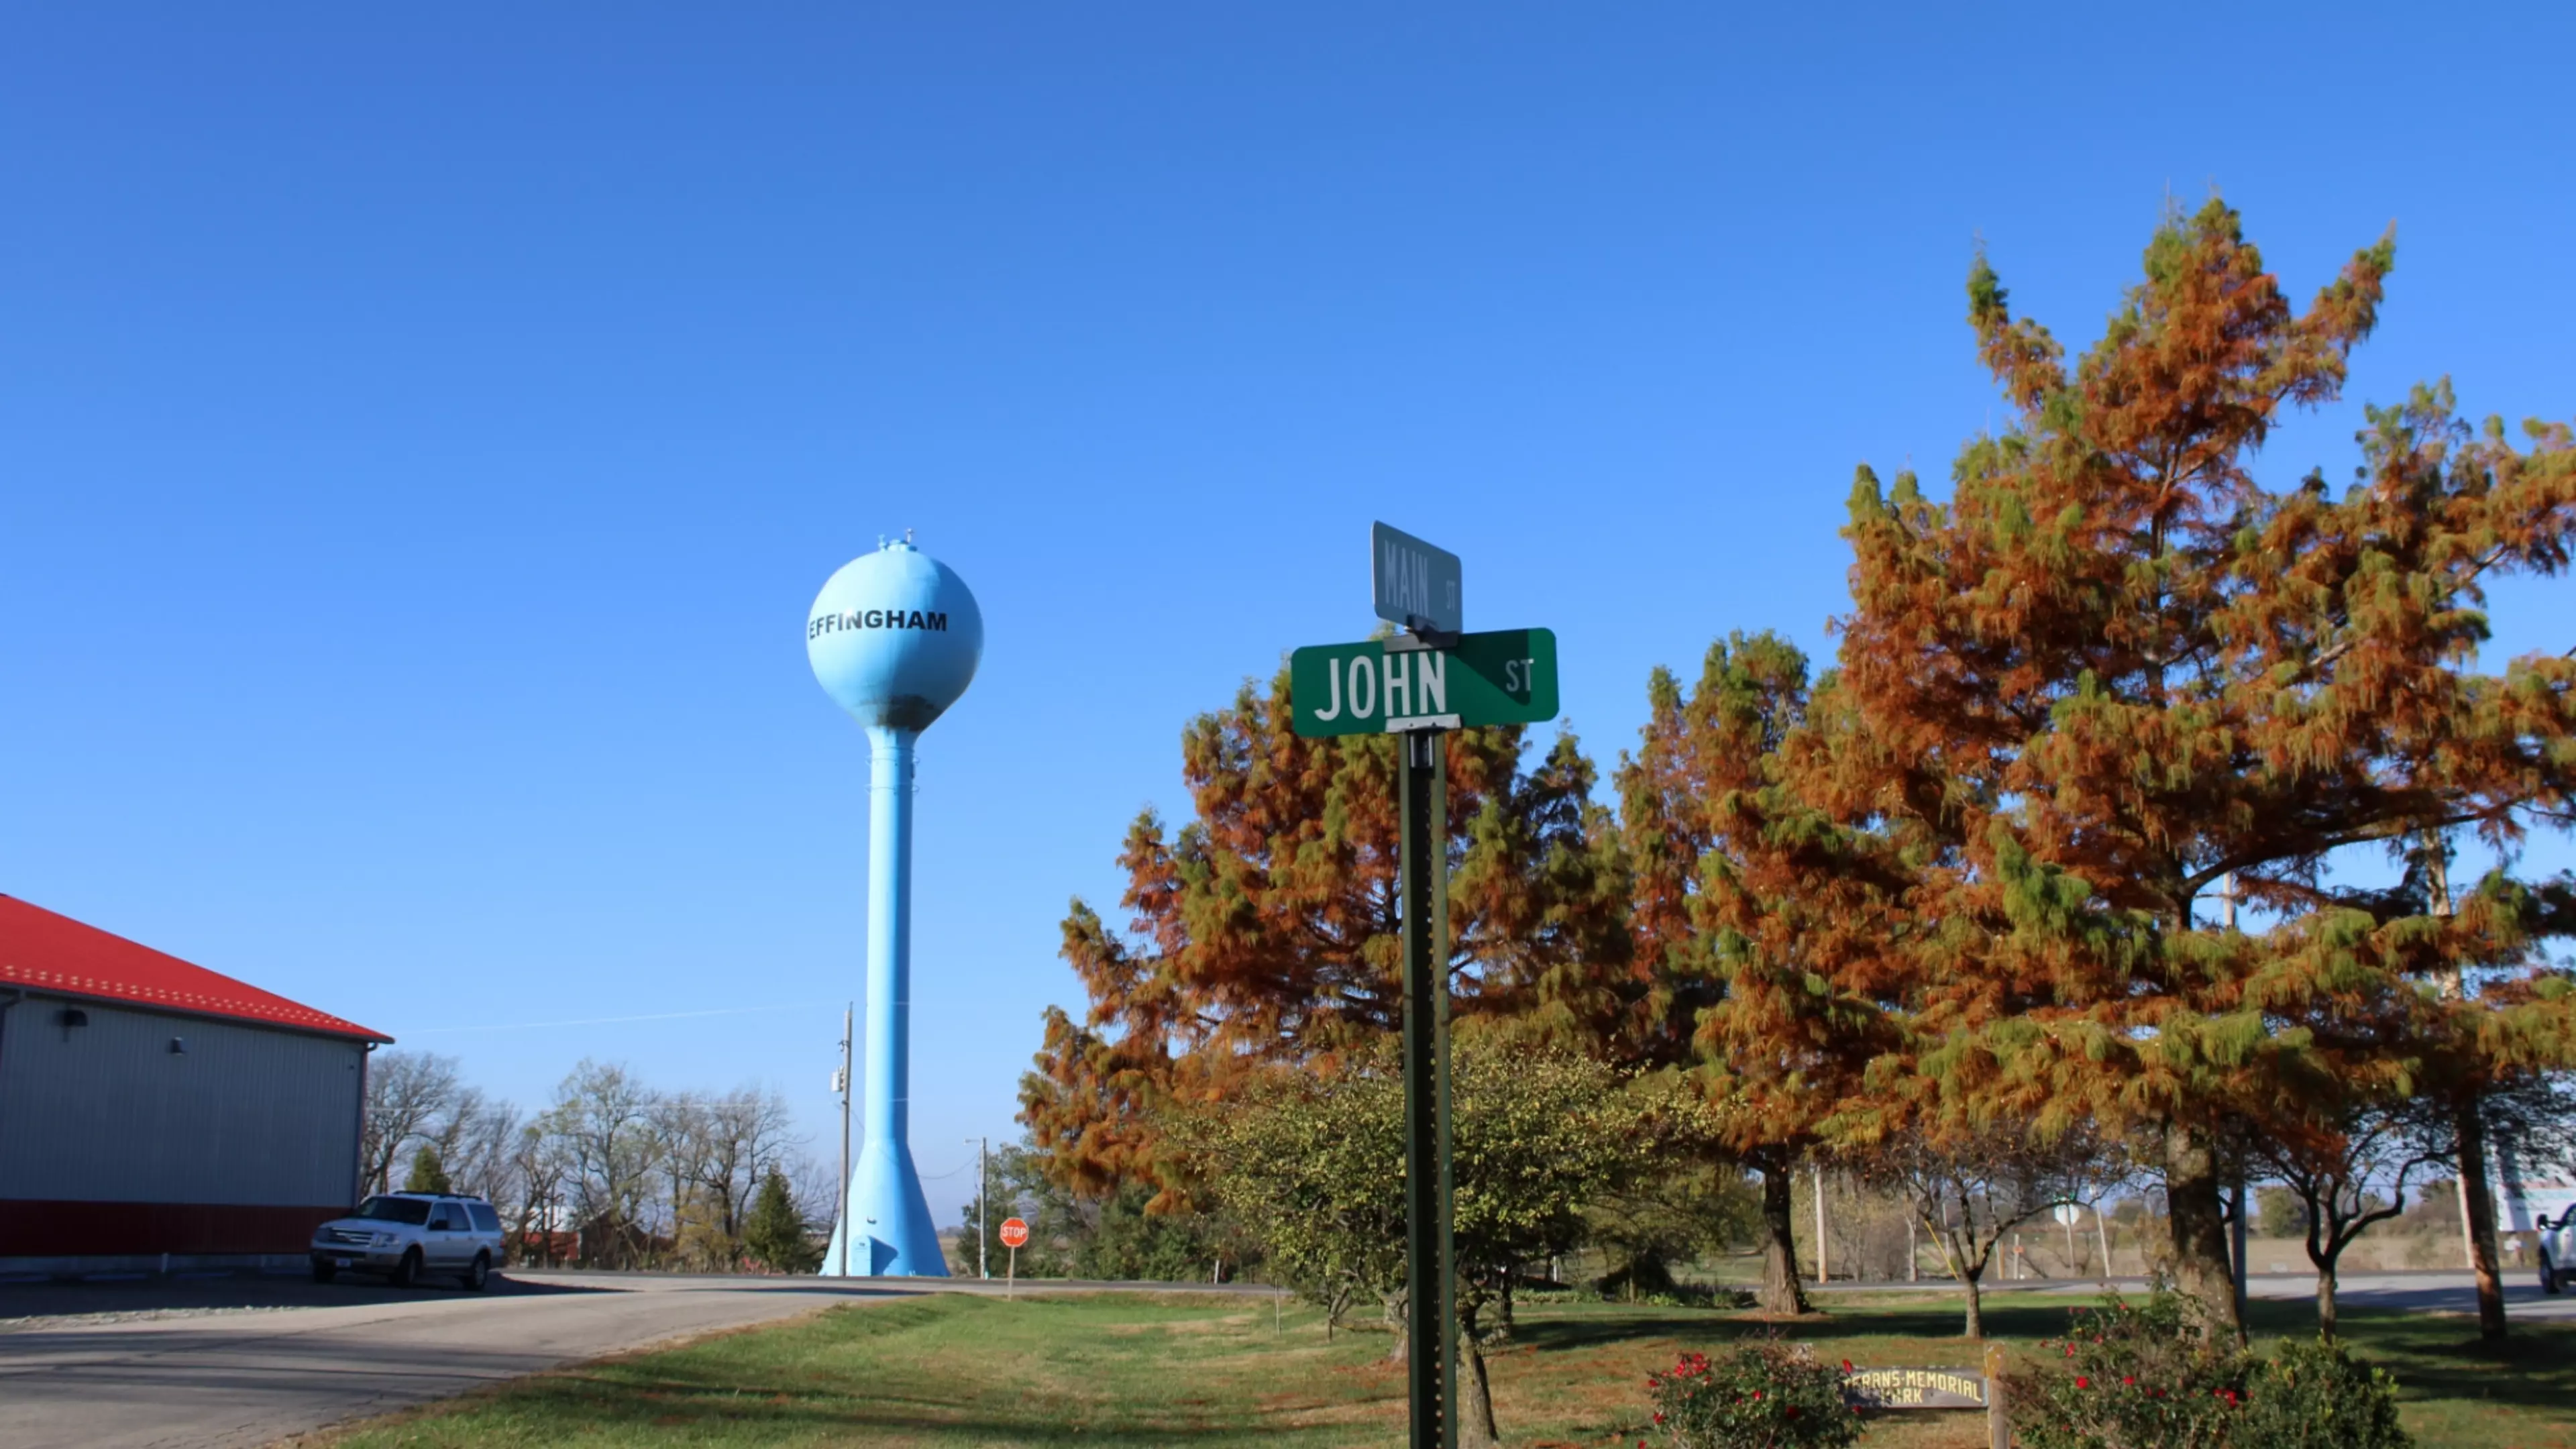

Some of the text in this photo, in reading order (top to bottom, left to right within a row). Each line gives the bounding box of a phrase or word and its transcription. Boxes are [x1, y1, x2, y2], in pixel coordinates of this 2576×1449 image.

[1385, 539, 1456, 618] MAIN ST
[809, 610, 947, 640] EFFINGHAM
[1314, 651, 1534, 721] JOHN ST
[1002, 1226, 1027, 1238] STOP
